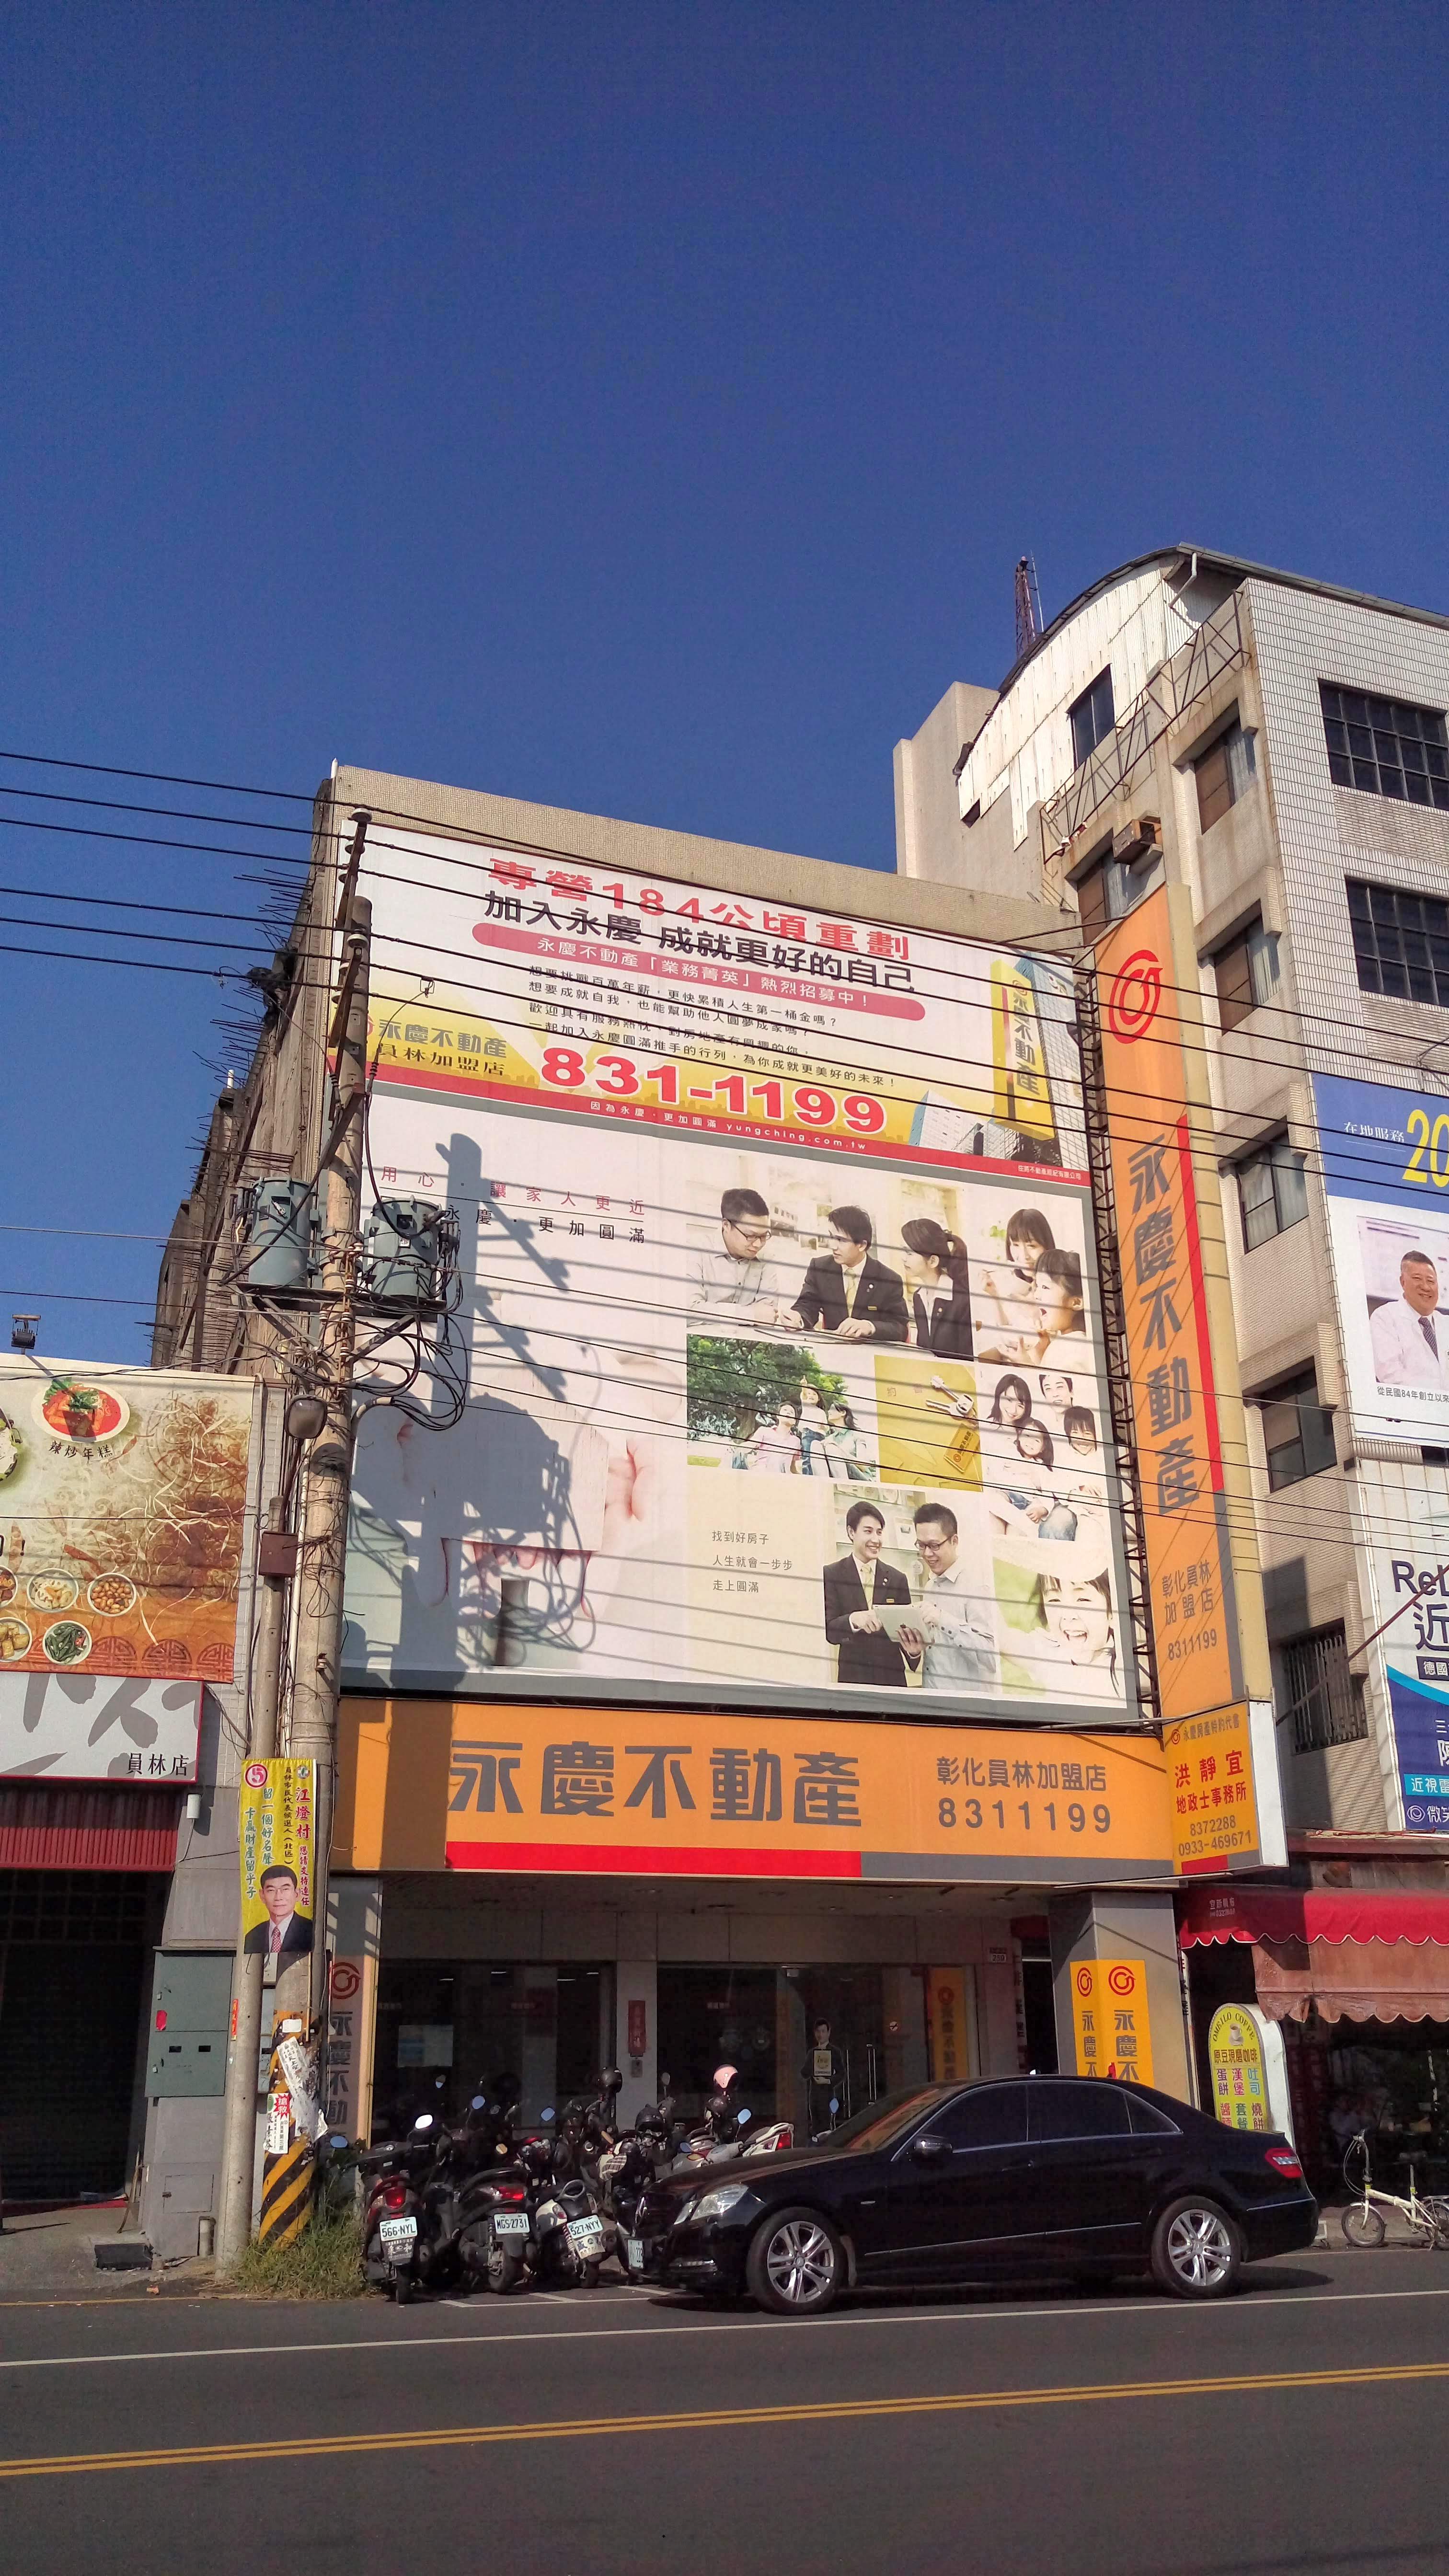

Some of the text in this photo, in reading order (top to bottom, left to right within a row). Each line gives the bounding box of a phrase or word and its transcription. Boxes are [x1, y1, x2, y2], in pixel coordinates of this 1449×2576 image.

[488, 857, 909, 961] 專營184公頃重劃
[484, 891, 915, 993] 加入永慶 成就更好的自己
[379, 1019, 507, 1058] 永慶不動產
[379, 1043, 505, 1076] 員林加盟店
[541, 1047, 886, 1133] 831-1199
[726, 1124, 866, 1150] yungching.com.tw
[1344, 1109, 1449, 1188] 在地服務 20
[1127, 1132, 1200, 1516] 永慶不動產
[1377, 1385, 1449, 1403] 從民國84年創立以來
[49, 1441, 113, 1460] 辣炒年糕
[712, 1530, 770, 1545] 找到好房子
[713, 1554, 793, 1571] 人生就會一步步
[1162, 1559, 1211, 1599] 彰化員林
[713, 1579, 759, 1593] 走上圓滿
[1164, 1587, 1214, 1626] 加盟店
[1167, 1628, 1218, 1662] 8311199
[1423, 1660, 1449, 1677] 德國
[126, 1752, 189, 1777] 員林店
[252, 1767, 264, 1783] 5
[936, 1756, 1106, 1792] 彰化員林加盟店
[1174, 1749, 1244, 1789] 洪靜宜
[447, 1740, 862, 1827] 永慶不動產
[1175, 1782, 1247, 1815] 地政士事務所
[261, 1787, 274, 1865] 留一個好名聲
[938, 1797, 1111, 1833] 8311199
[1189, 1814, 1236, 1837] 8372288
[1178, 1830, 1252, 1857] 0933-469671
[299, 1846, 310, 1906] 懇請支持連任
[1114, 2010, 1139, 2081] 永慶不
[1213, 2047, 1258, 2063] 原豆現磨咖啡
[326, 2011, 354, 2147] 永慶不動
[1217, 2068, 1229, 2096] 蛋餅
[1232, 2068, 1245, 2096] 漢堡
[1248, 2068, 1260, 2096] 吐司
[278, 2097, 288, 2114] 搶救
[1252, 2103, 1265, 2131] 燒餅
